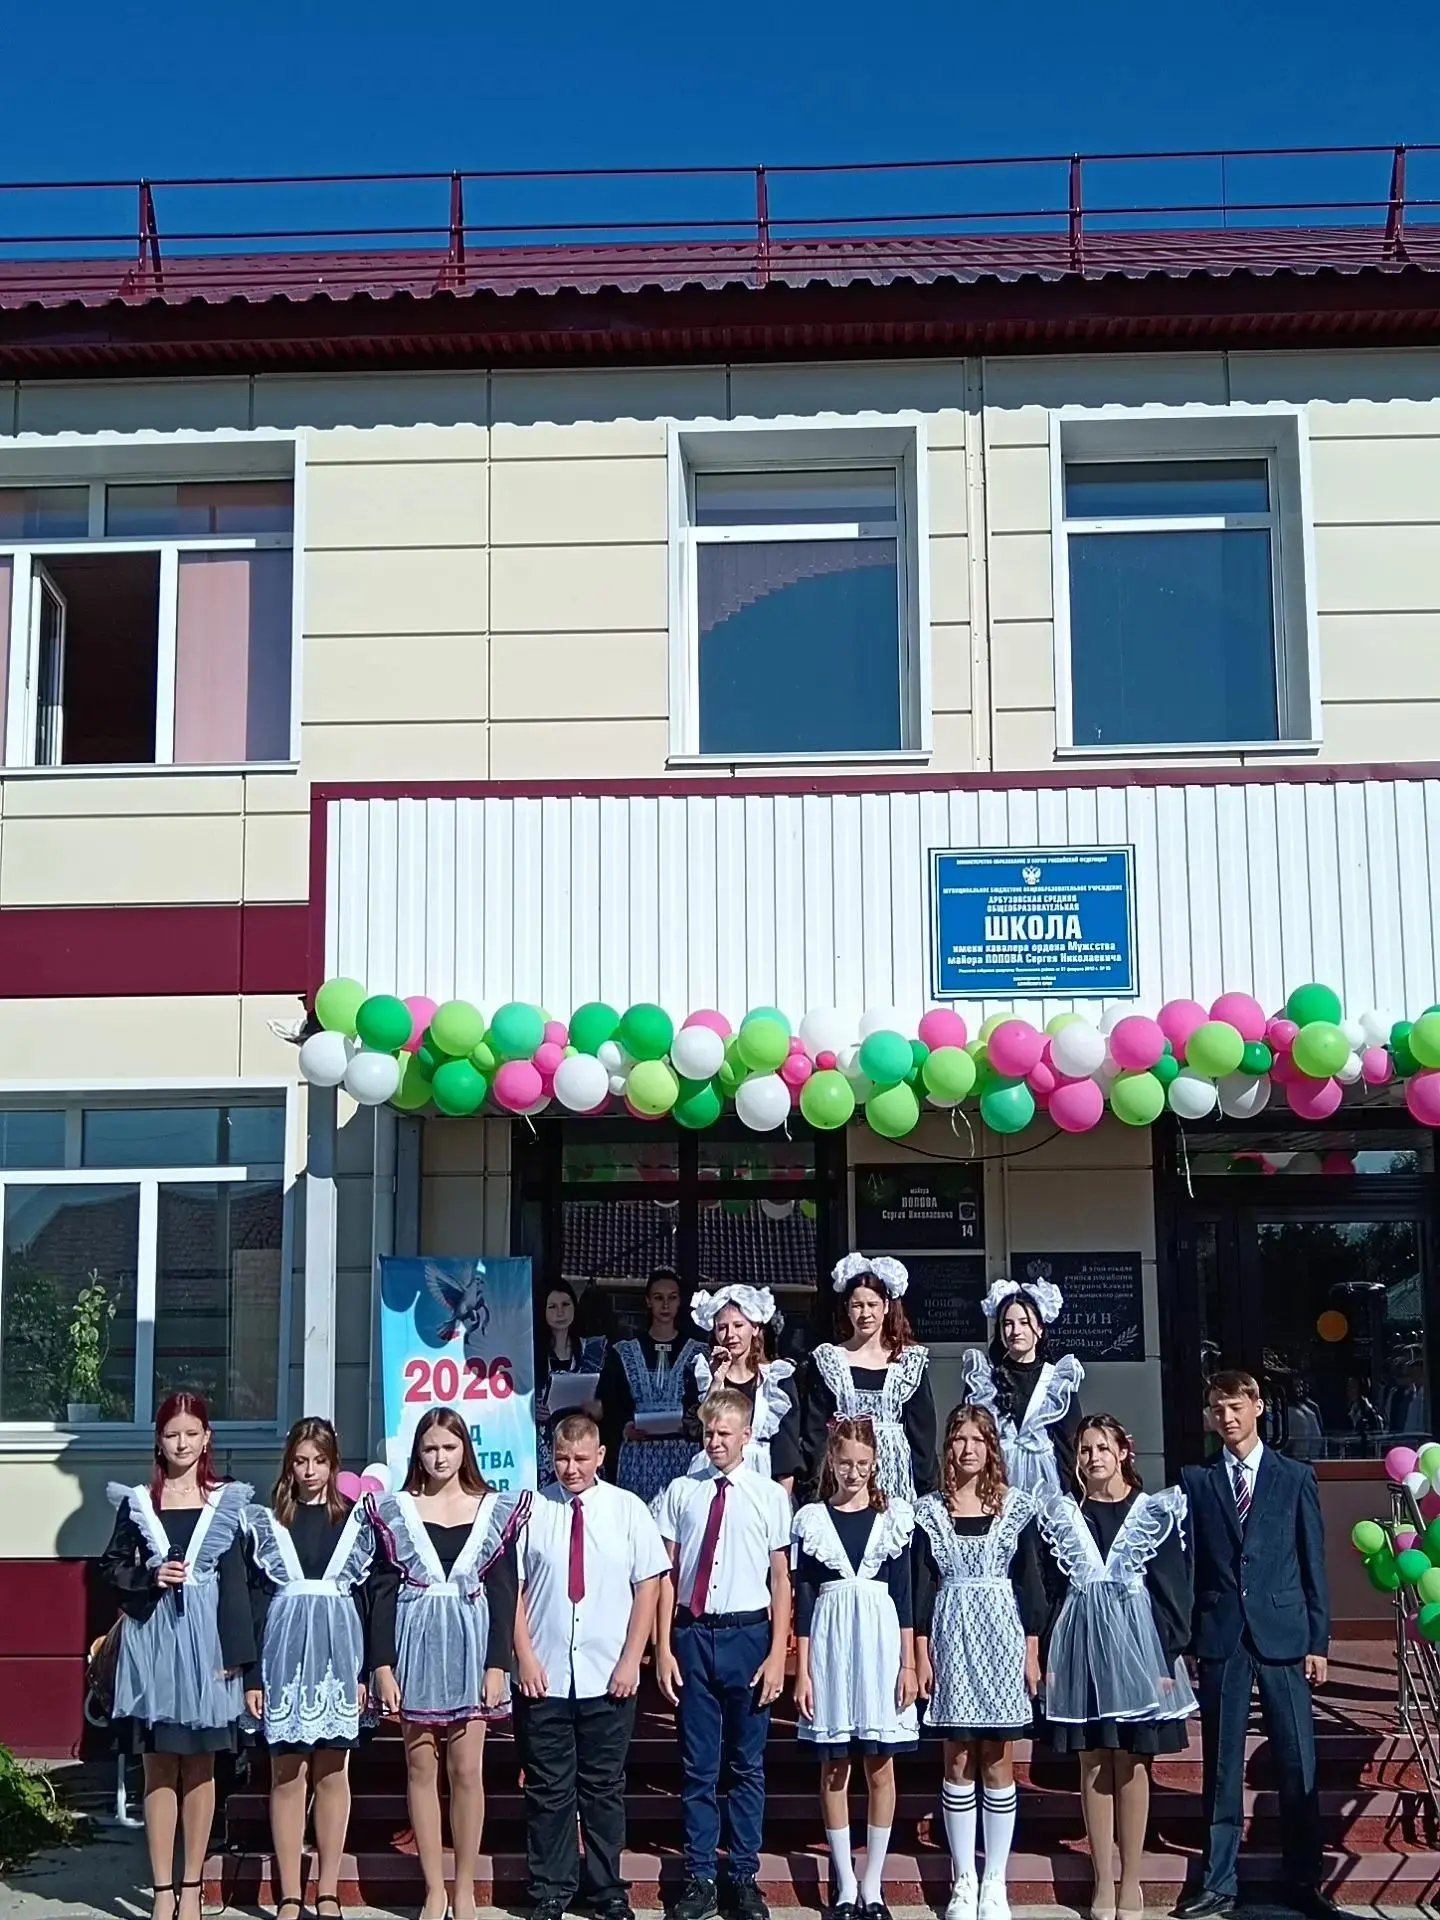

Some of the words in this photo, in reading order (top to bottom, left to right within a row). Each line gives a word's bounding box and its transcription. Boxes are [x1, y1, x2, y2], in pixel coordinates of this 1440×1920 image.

[988, 896, 1042, 904] АРБУЗОВСКАЯ
[987, 903, 1079, 912] ОБЩЕОБРАЗОВАТЕЛЬНАЯ
[984, 915, 1082, 941] ШКОЛА
[985, 944, 1029, 953] кавалера
[1032, 943, 1065, 953] ордена
[1068, 941, 1116, 952] Мужества
[948, 955, 983, 966] майора
[985, 954, 1023, 963] ПОПОВА
[1026, 953, 1058, 965] Сергея
[1060, 953, 1122, 962] Николаевича
[962, 1224, 973, 1236] 14
[1062, 1312, 1112, 1324] ЯГИН
[405, 1356, 514, 1402] 2026
